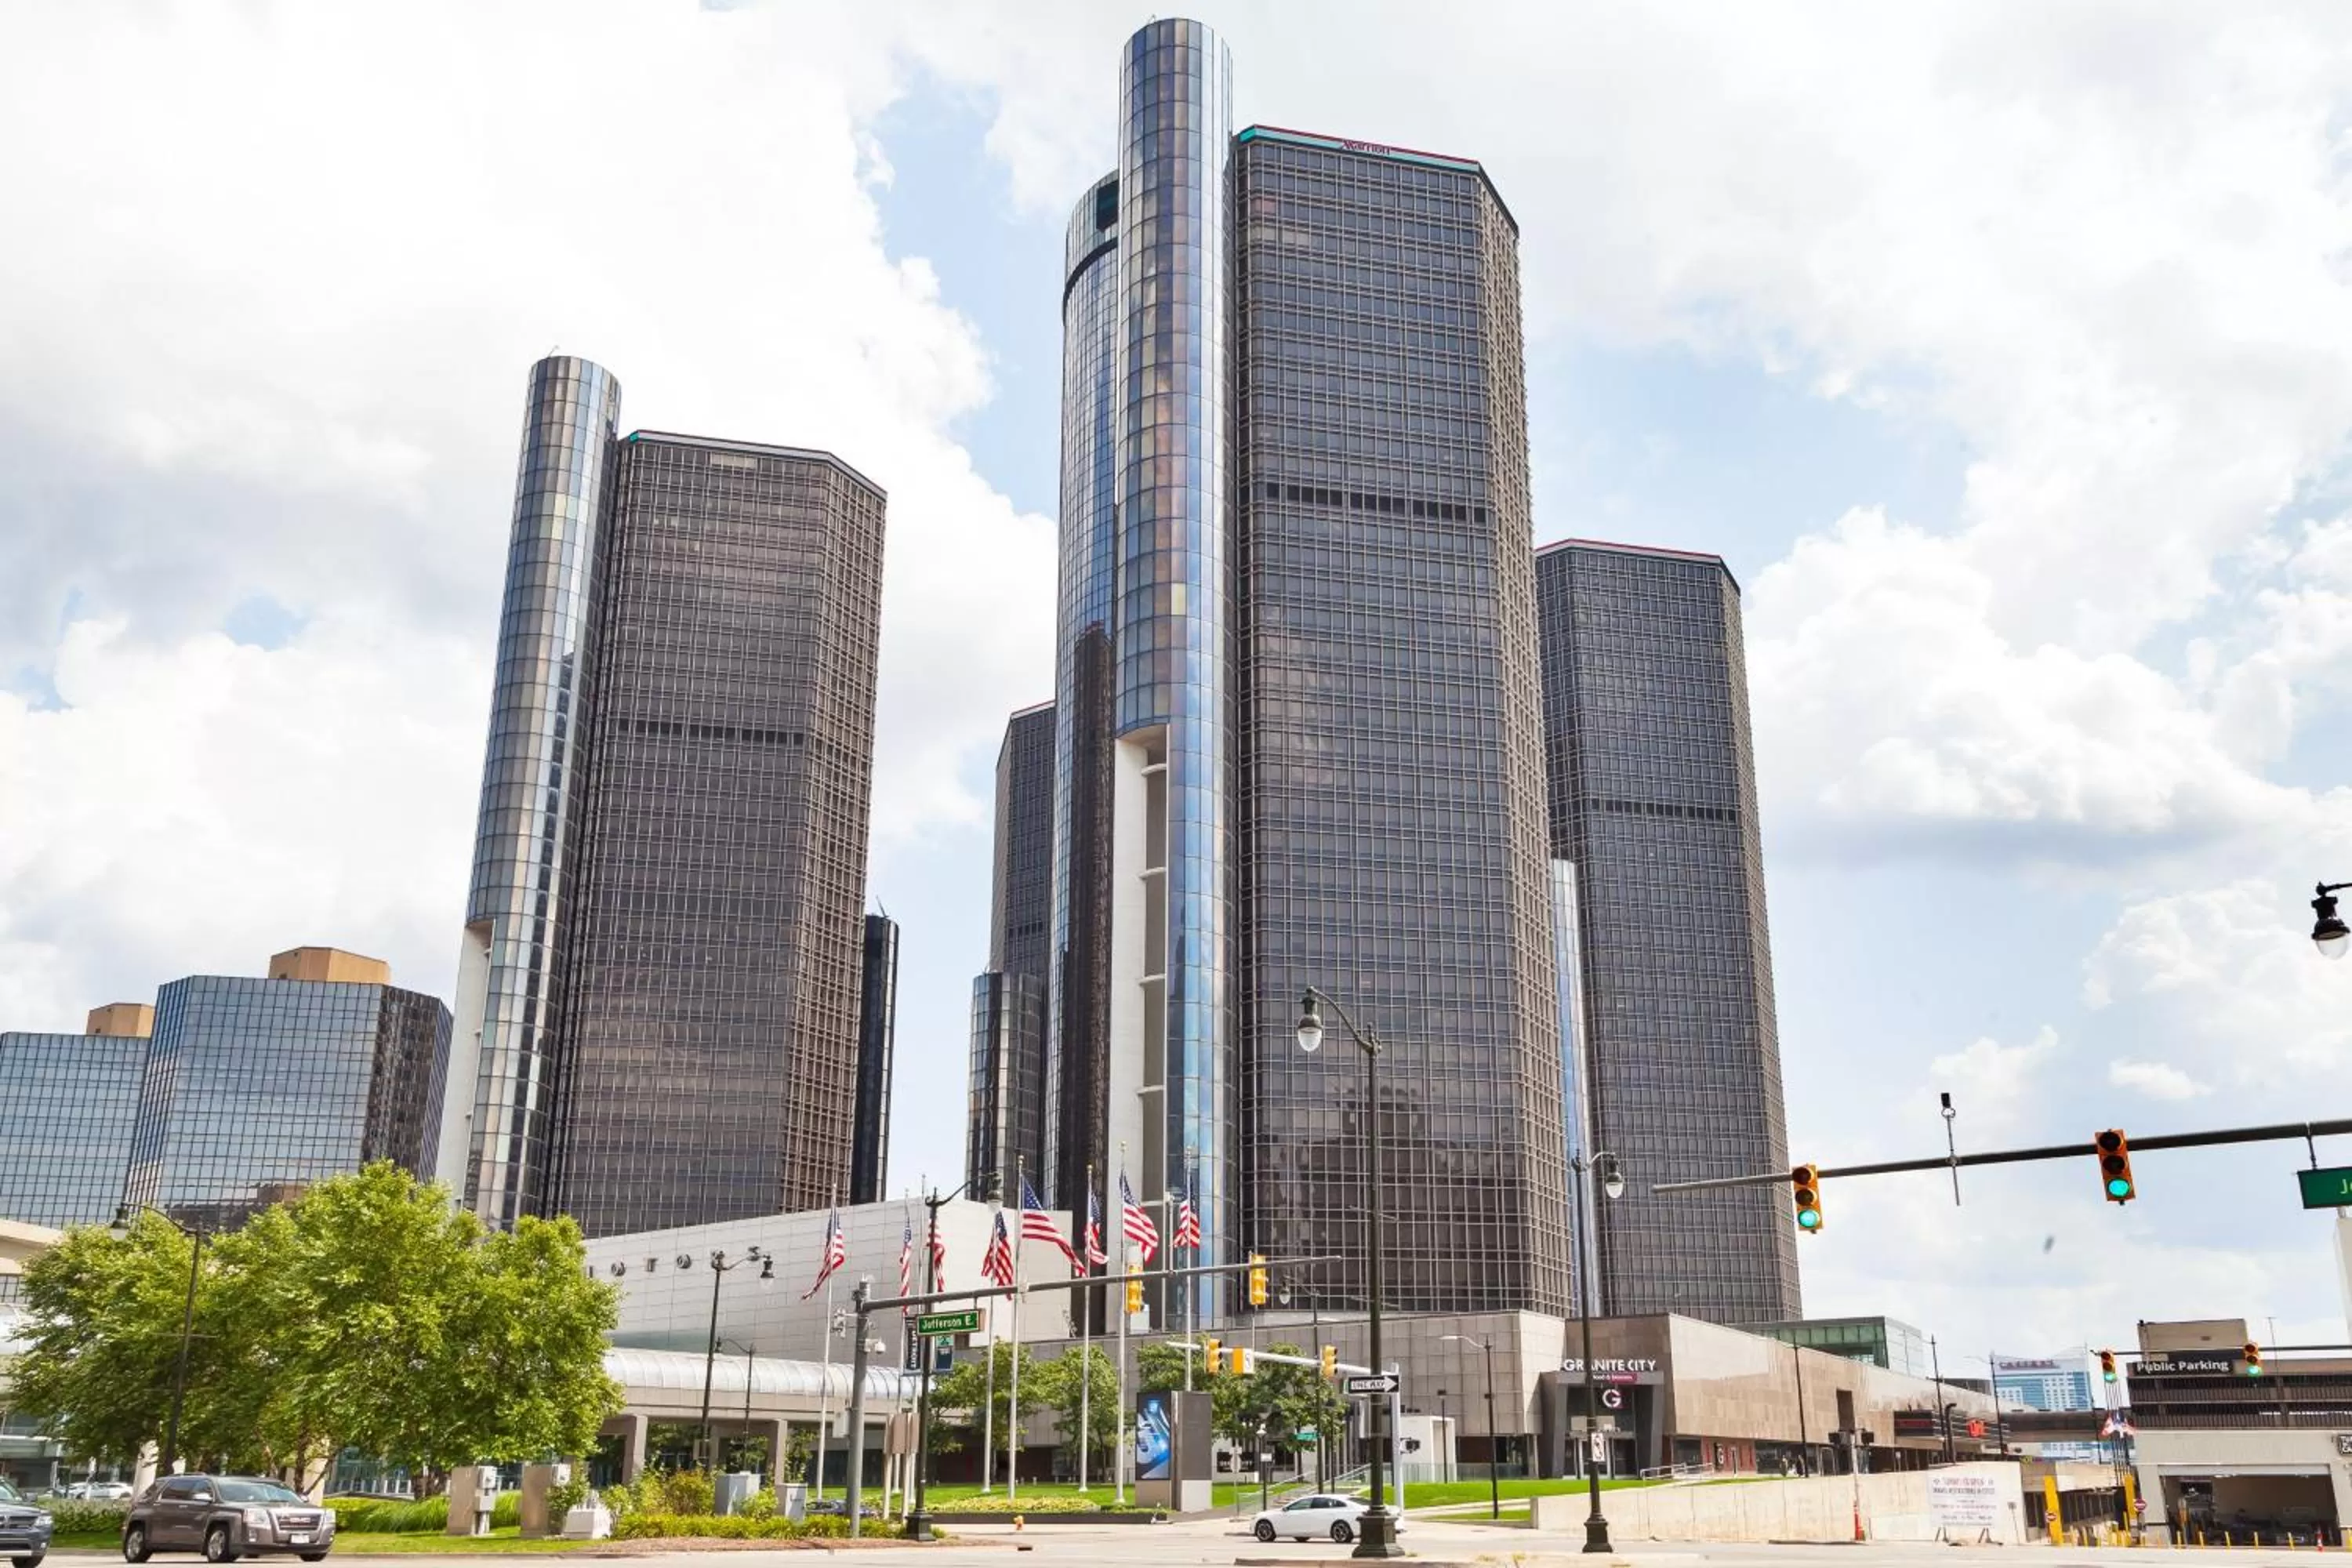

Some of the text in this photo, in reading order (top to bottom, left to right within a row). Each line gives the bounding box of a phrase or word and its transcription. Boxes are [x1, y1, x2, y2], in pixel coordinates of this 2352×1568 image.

[1341, 139, 1390, 155] Marriott
[922, 1319, 962, 1330] Jefferson
[1627, 1359, 1656, 1370] CITY
[2137, 1360, 2229, 1373] Public Parking
[1352, 1381, 1367, 1389] ONE
